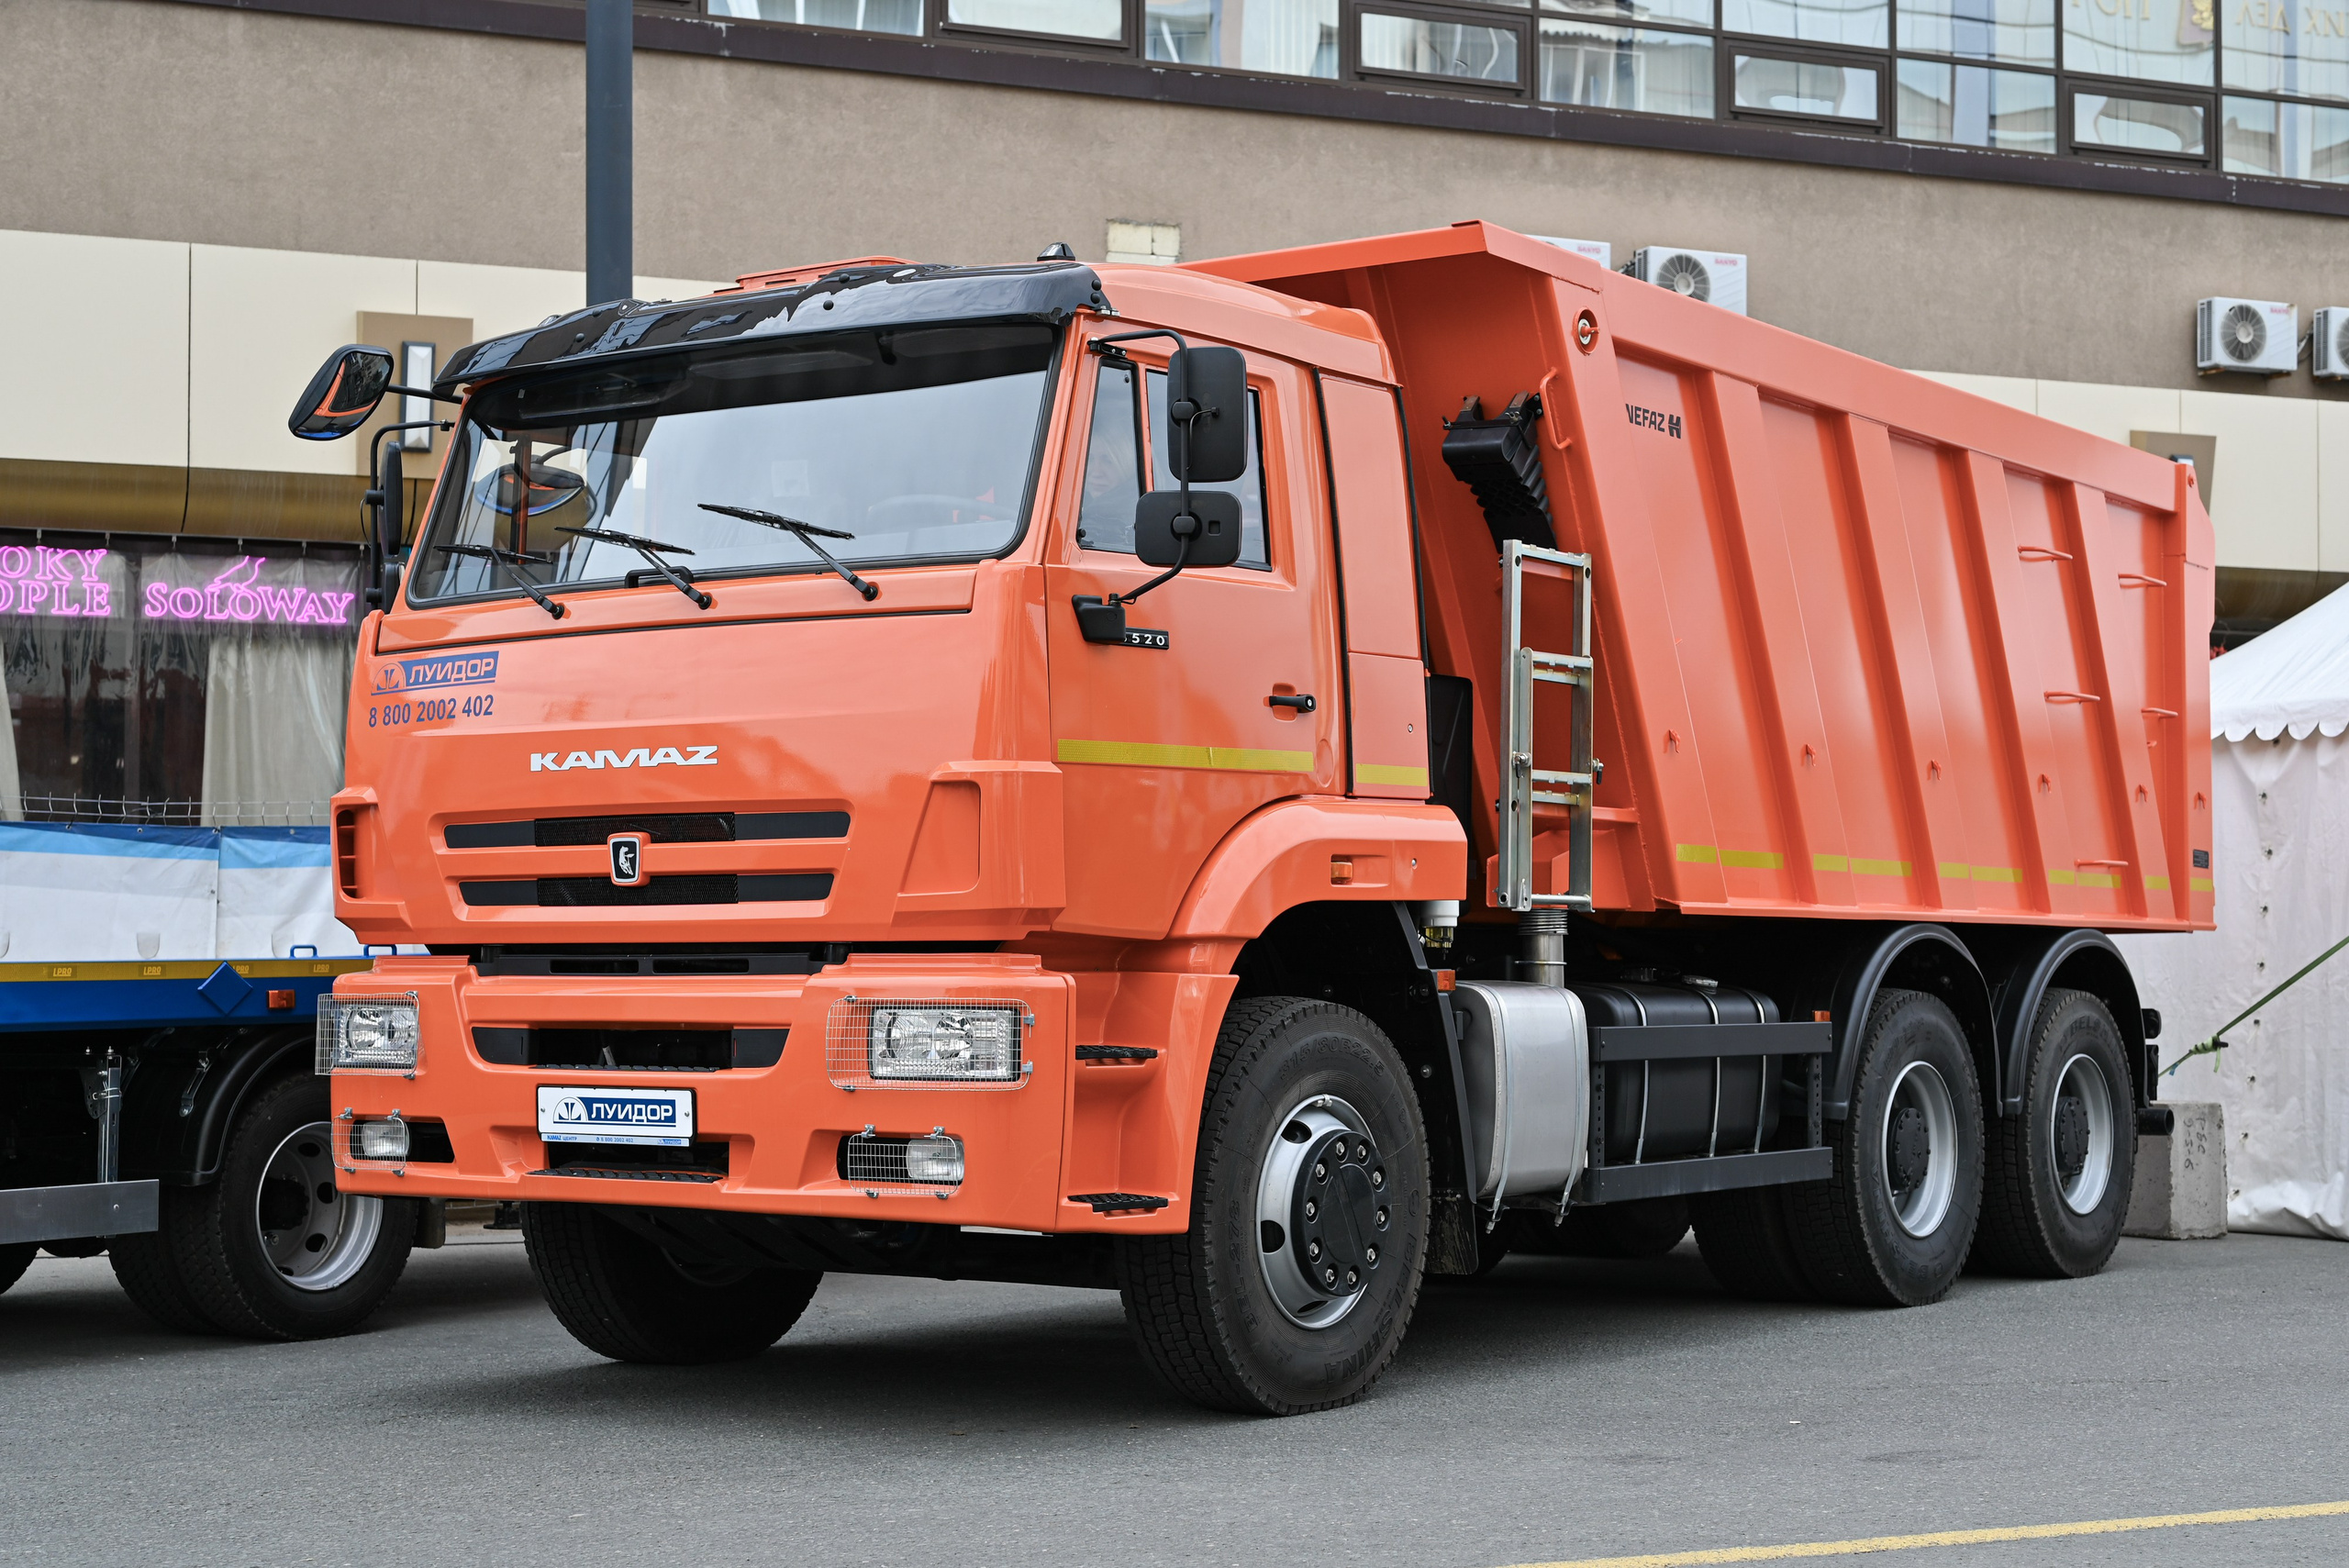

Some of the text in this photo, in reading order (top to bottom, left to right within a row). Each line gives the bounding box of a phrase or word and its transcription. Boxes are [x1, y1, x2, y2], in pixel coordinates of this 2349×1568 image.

[145, 582, 354, 624] SOLOWAY
[1124, 633, 1165, 646] 520
[409, 658, 495, 684] ЛУИДОР
[369, 695, 494, 728] 8 800 2002 402
[530, 745, 718, 772] KAMAZ
[591, 1103, 674, 1123] ЛУИДОР
